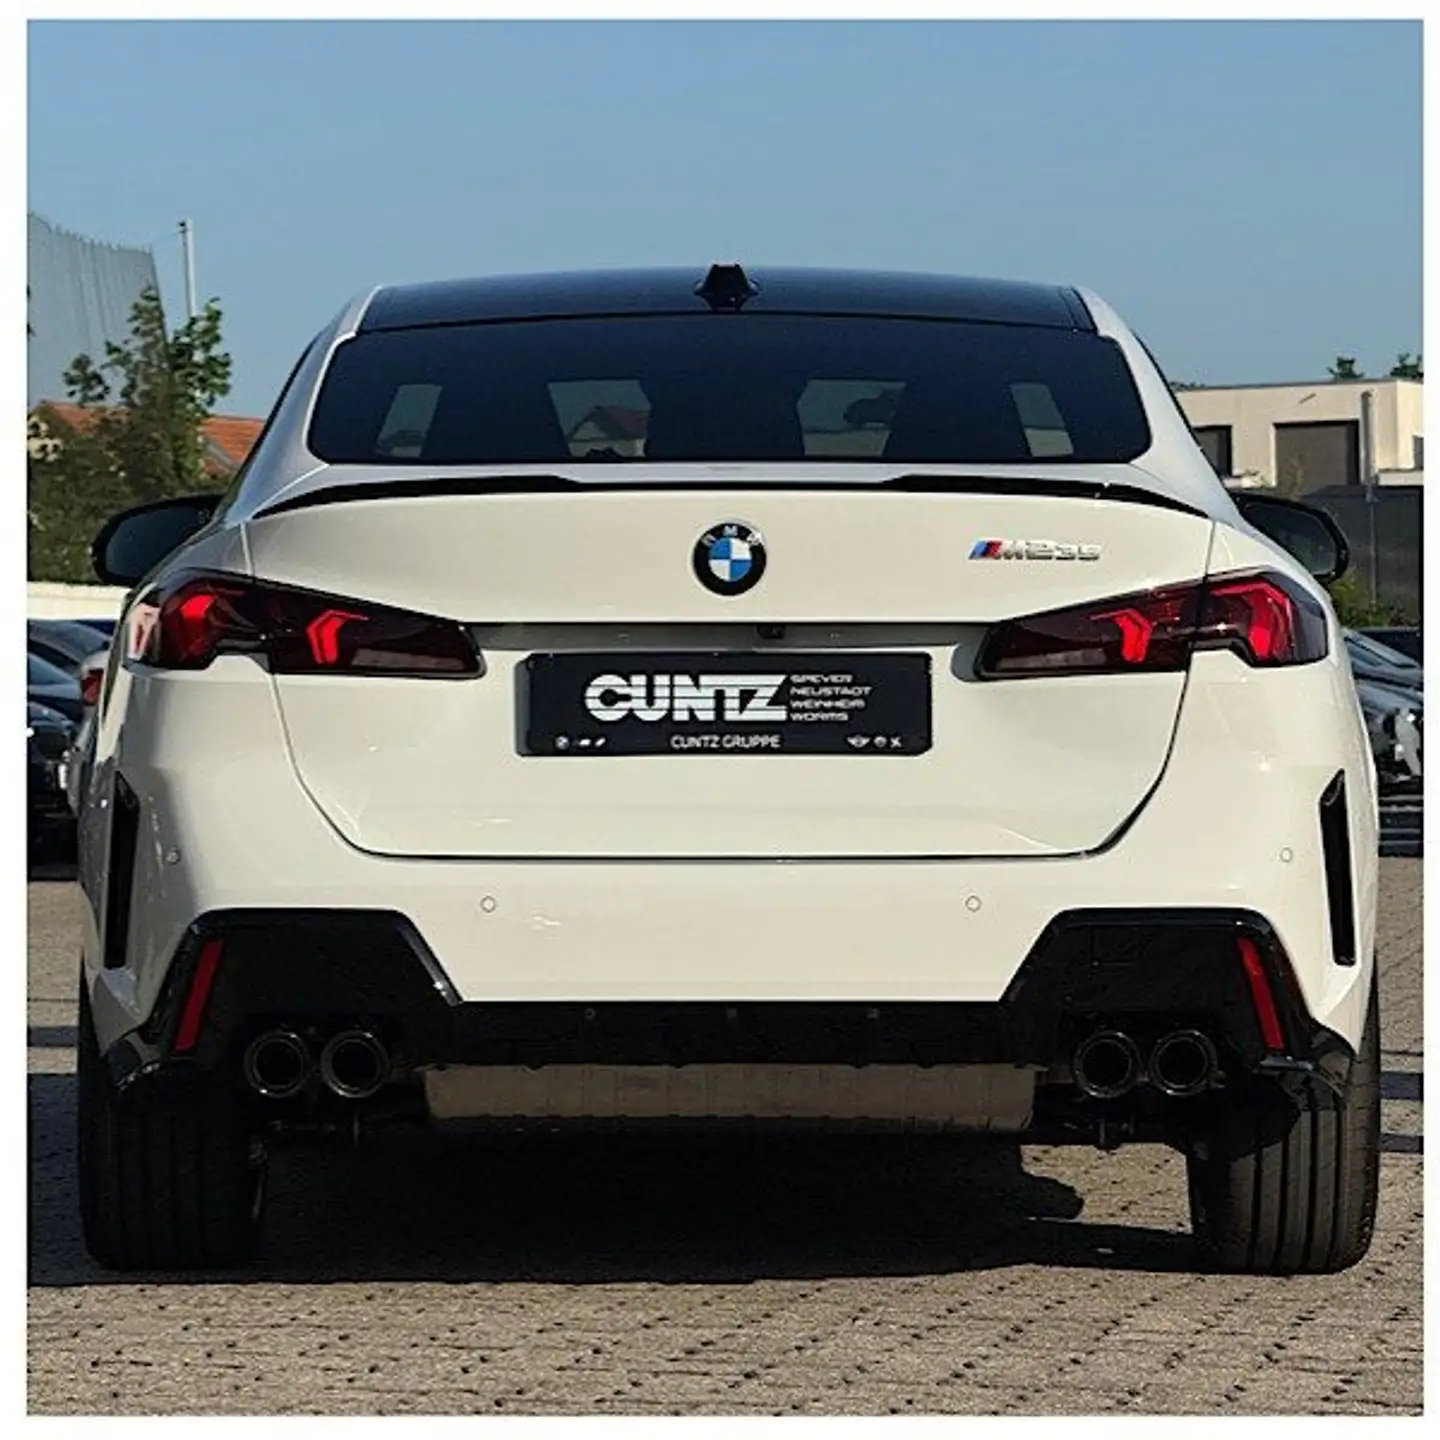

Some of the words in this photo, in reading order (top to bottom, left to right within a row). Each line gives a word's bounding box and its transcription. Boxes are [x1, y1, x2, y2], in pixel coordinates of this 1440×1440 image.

[584, 673, 788, 722] CUNTZ
[789, 686, 872, 697] NEUSTADT
[789, 710, 850, 722] WORMS
[670, 734, 720, 749] CUNTZ
[721, 734, 781, 749] GRUPPE
